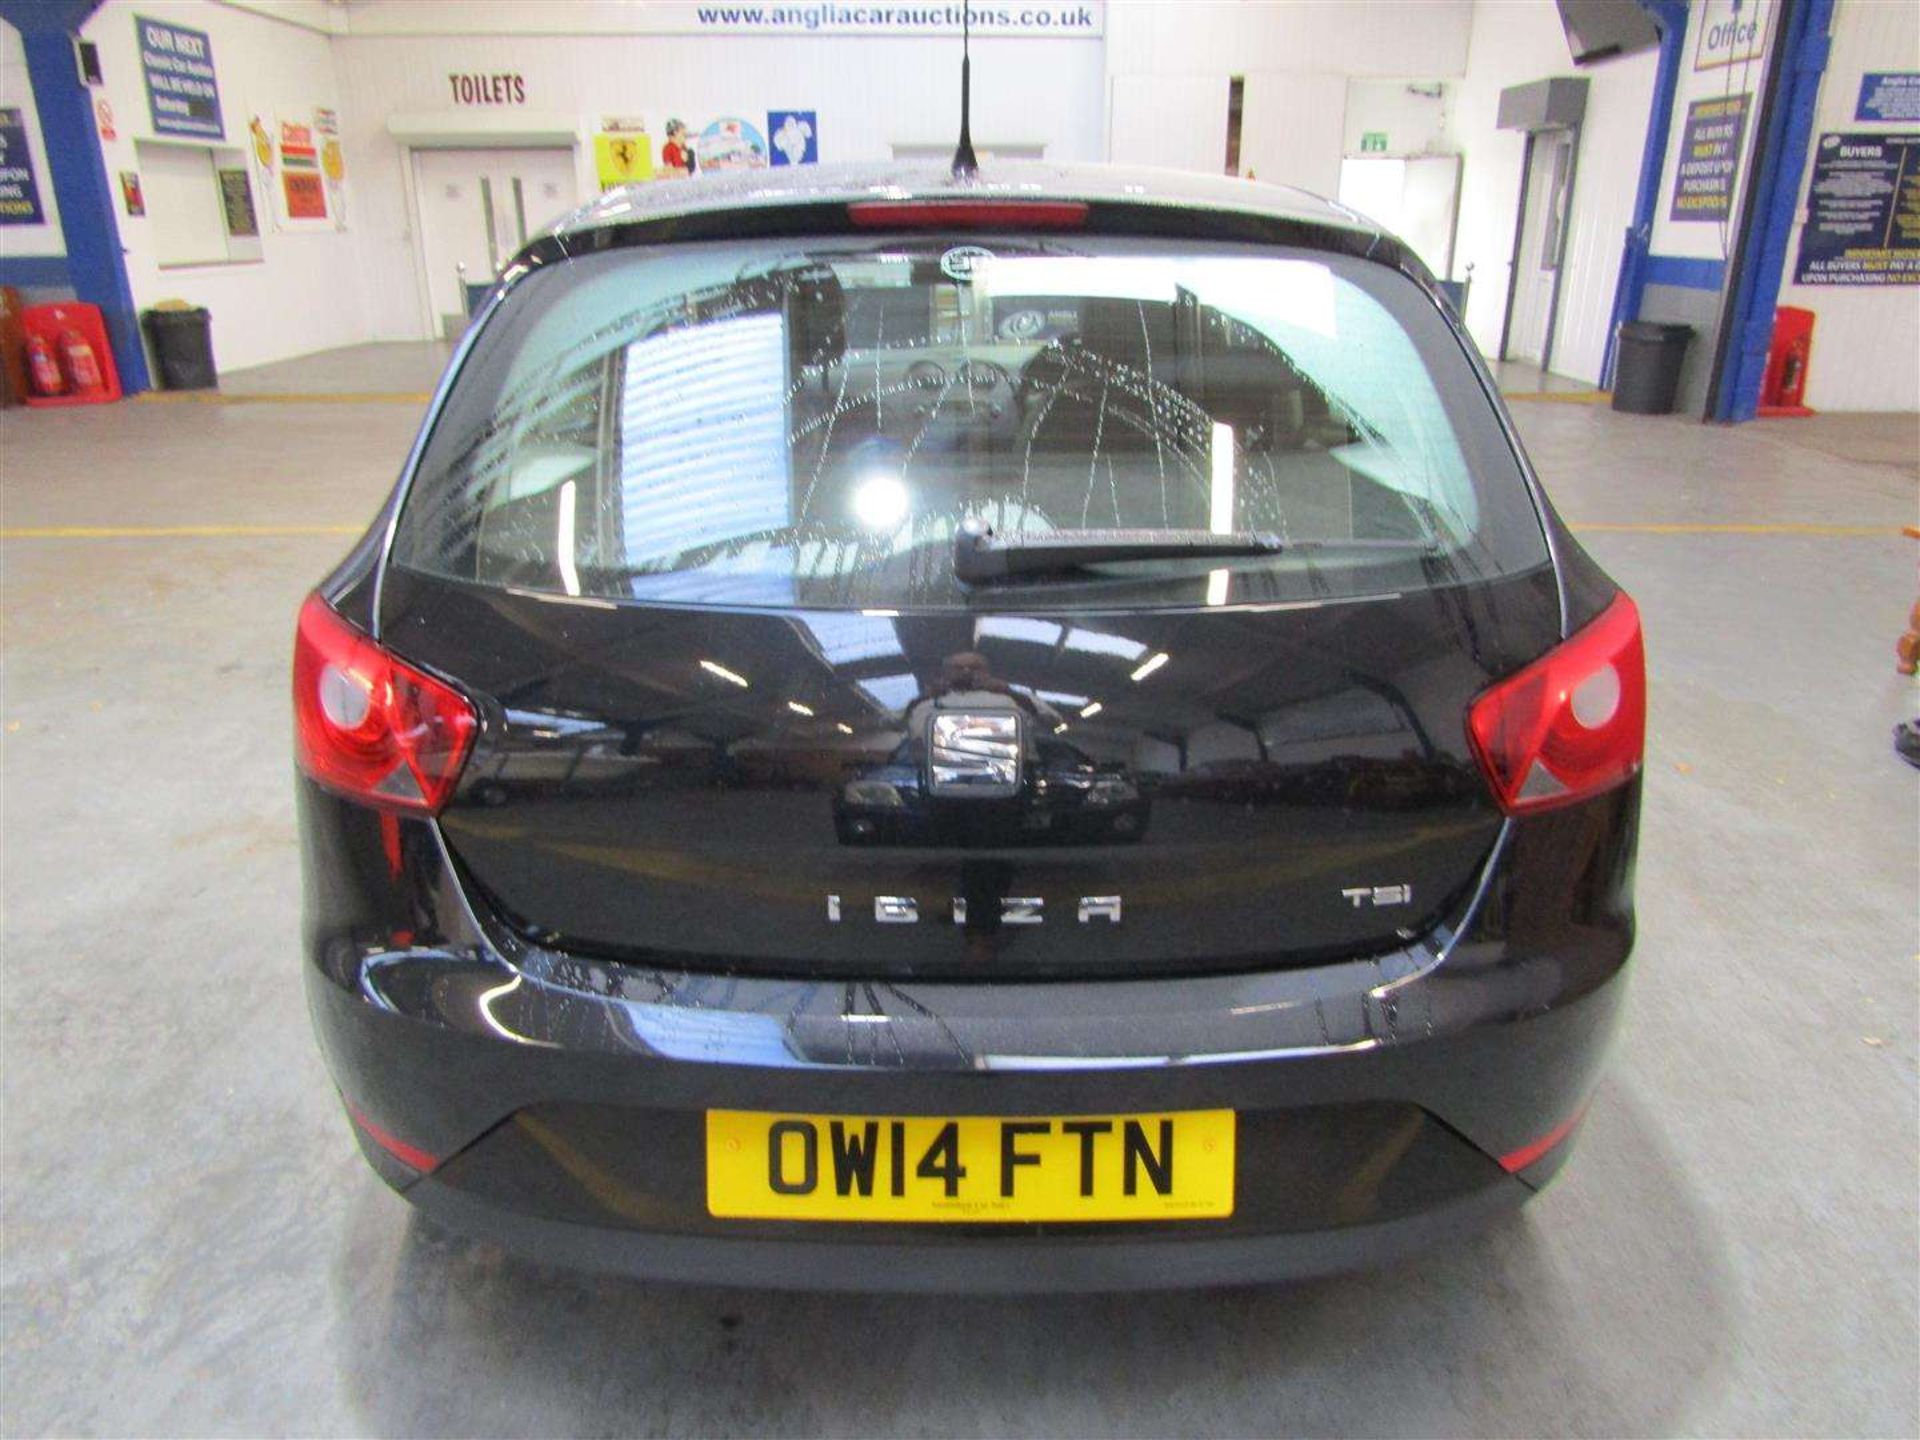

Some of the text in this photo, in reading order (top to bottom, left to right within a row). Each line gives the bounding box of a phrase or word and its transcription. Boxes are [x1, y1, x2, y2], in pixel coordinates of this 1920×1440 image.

[697, 3, 1092, 30] www.angliacarauctions.co.uk
[1708, 22, 1757, 50] Office
[449, 75, 525, 103] TOILETS
[1840, 146, 1883, 158] BUYERS
[828, 895, 1122, 923] IBIZA
[769, 1119, 1173, 1197] OW14 FTN
